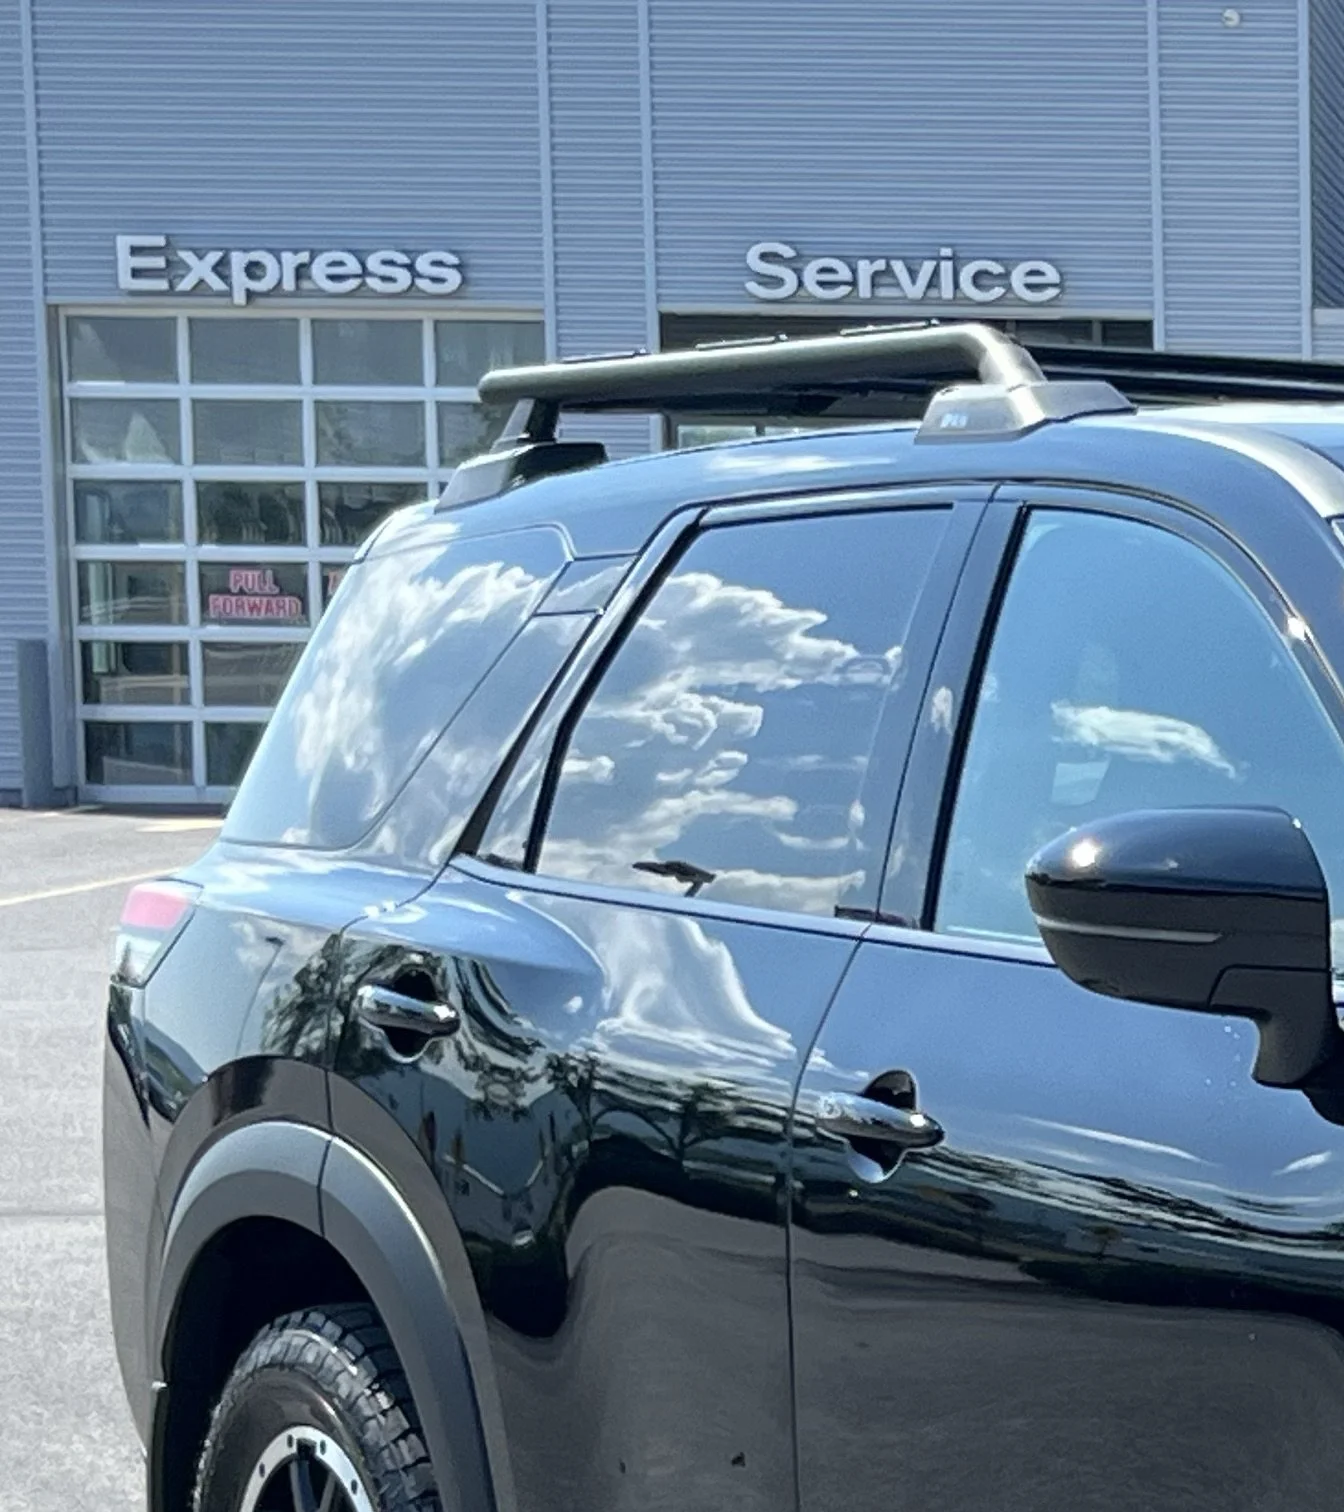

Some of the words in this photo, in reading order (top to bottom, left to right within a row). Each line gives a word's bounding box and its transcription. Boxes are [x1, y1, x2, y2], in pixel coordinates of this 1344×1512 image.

[115, 234, 465, 306] Express
[745, 241, 1063, 302] Service
[229, 568, 280, 594] PULL
[208, 595, 302, 618] FORWARD
